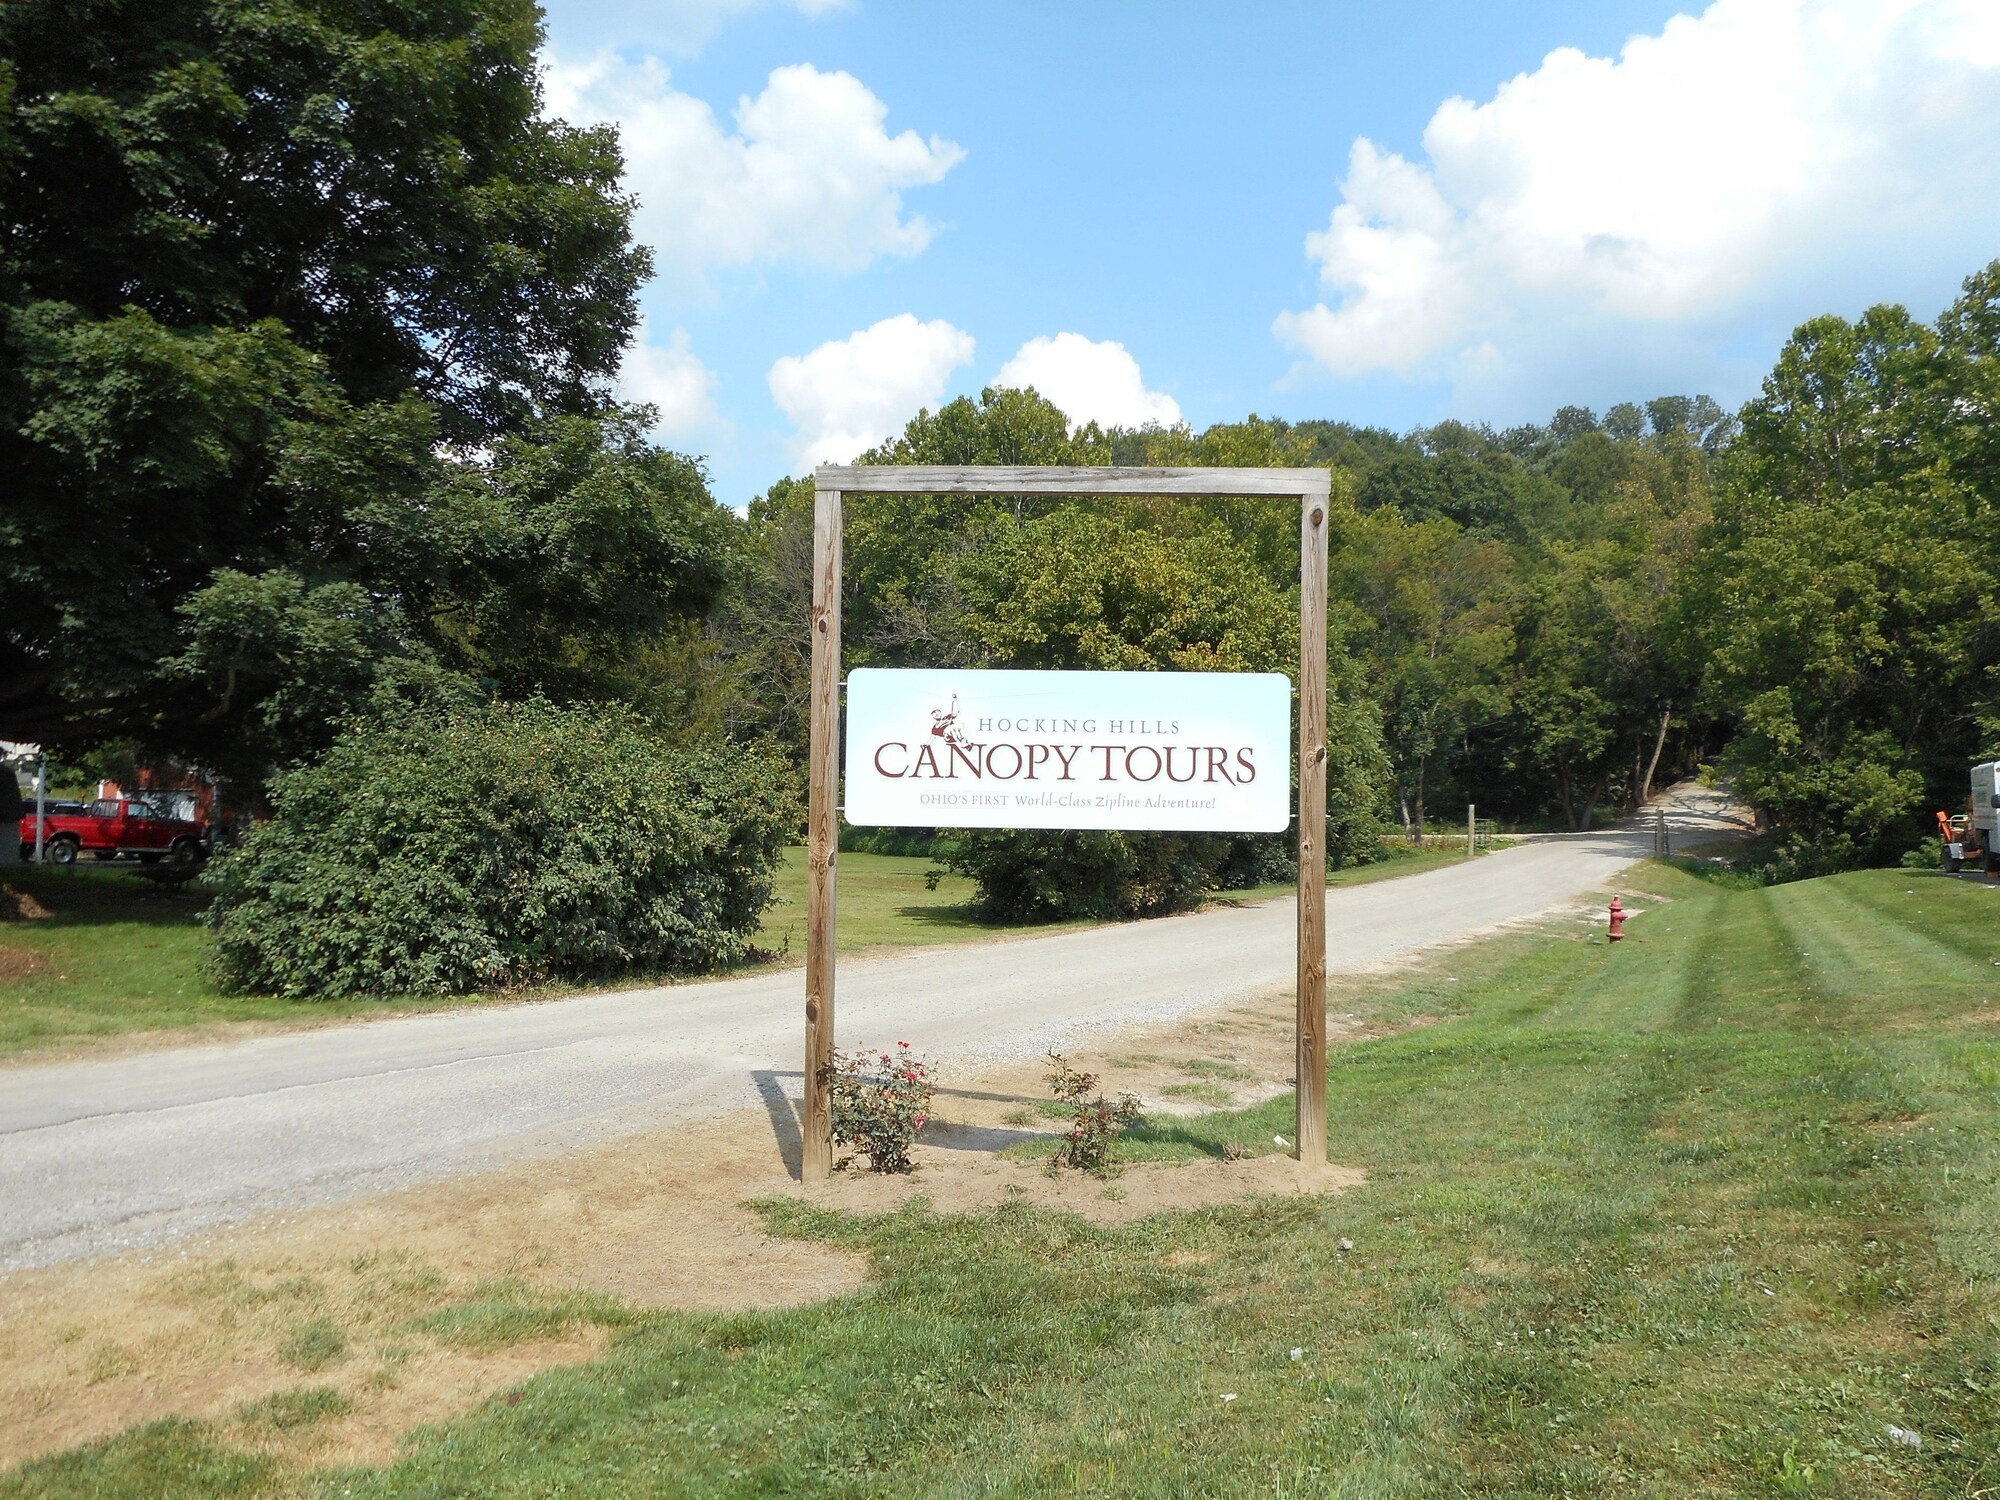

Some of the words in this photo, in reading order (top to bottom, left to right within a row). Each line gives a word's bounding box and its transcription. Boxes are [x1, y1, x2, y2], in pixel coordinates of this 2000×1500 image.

[978, 718, 1097, 733] HOCKING
[1110, 720, 1179, 734] HILLS
[874, 742, 1082, 780] CANOPY
[1091, 745, 1256, 787] TOURS
[920, 793, 969, 806] OHIO'S
[971, 794, 1009, 806] FIRST
[1015, 792, 1092, 807] World-Class
[1095, 793, 1141, 810] Zipline
[1144, 794, 1216, 809] Adventure!
